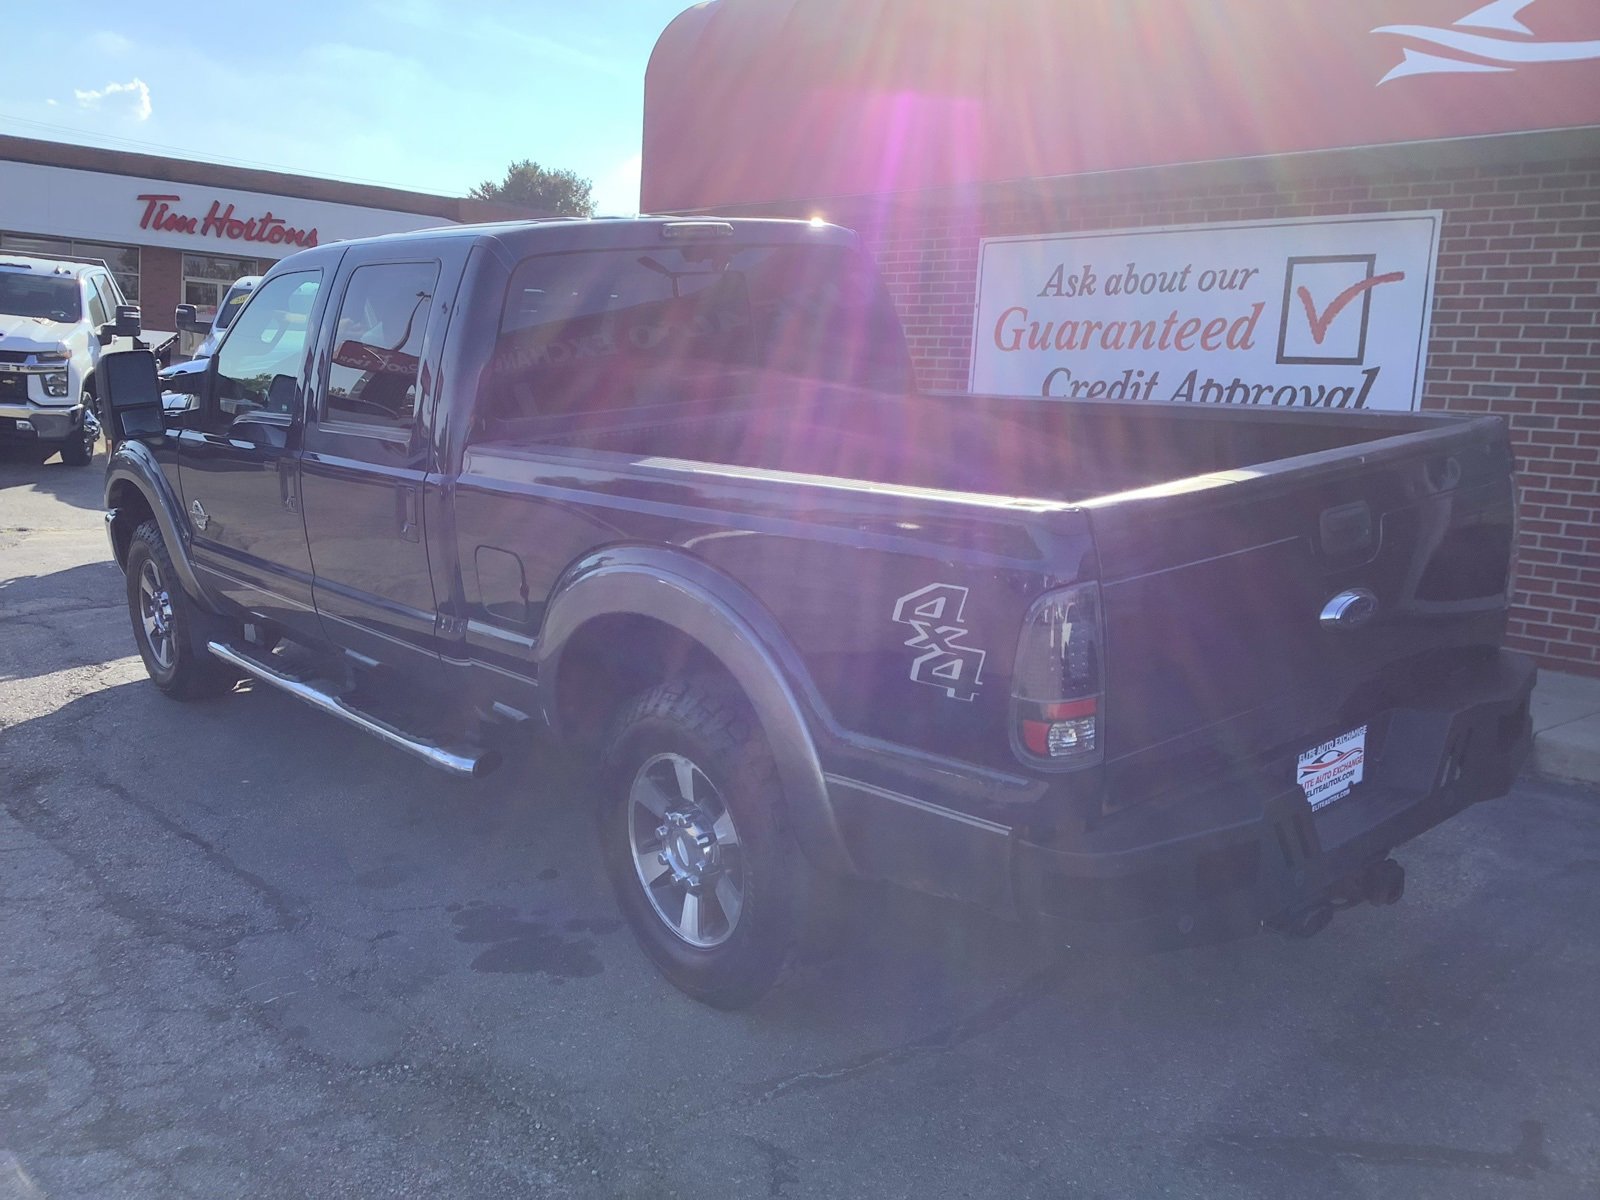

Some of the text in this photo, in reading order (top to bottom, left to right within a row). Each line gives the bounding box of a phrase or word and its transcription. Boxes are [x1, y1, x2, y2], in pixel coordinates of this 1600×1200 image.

[137, 194, 318, 248] Tim Hortons
[1037, 261, 1260, 298] Ask about our
[993, 300, 1266, 352] Guaranteed
[1042, 367, 1160, 400] Credit
[1306, 769, 1355, 798] ELITEAUTOX.COM
[1315, 771, 1332, 785] AUTO
[1332, 755, 1364, 777] EXCHANGE
